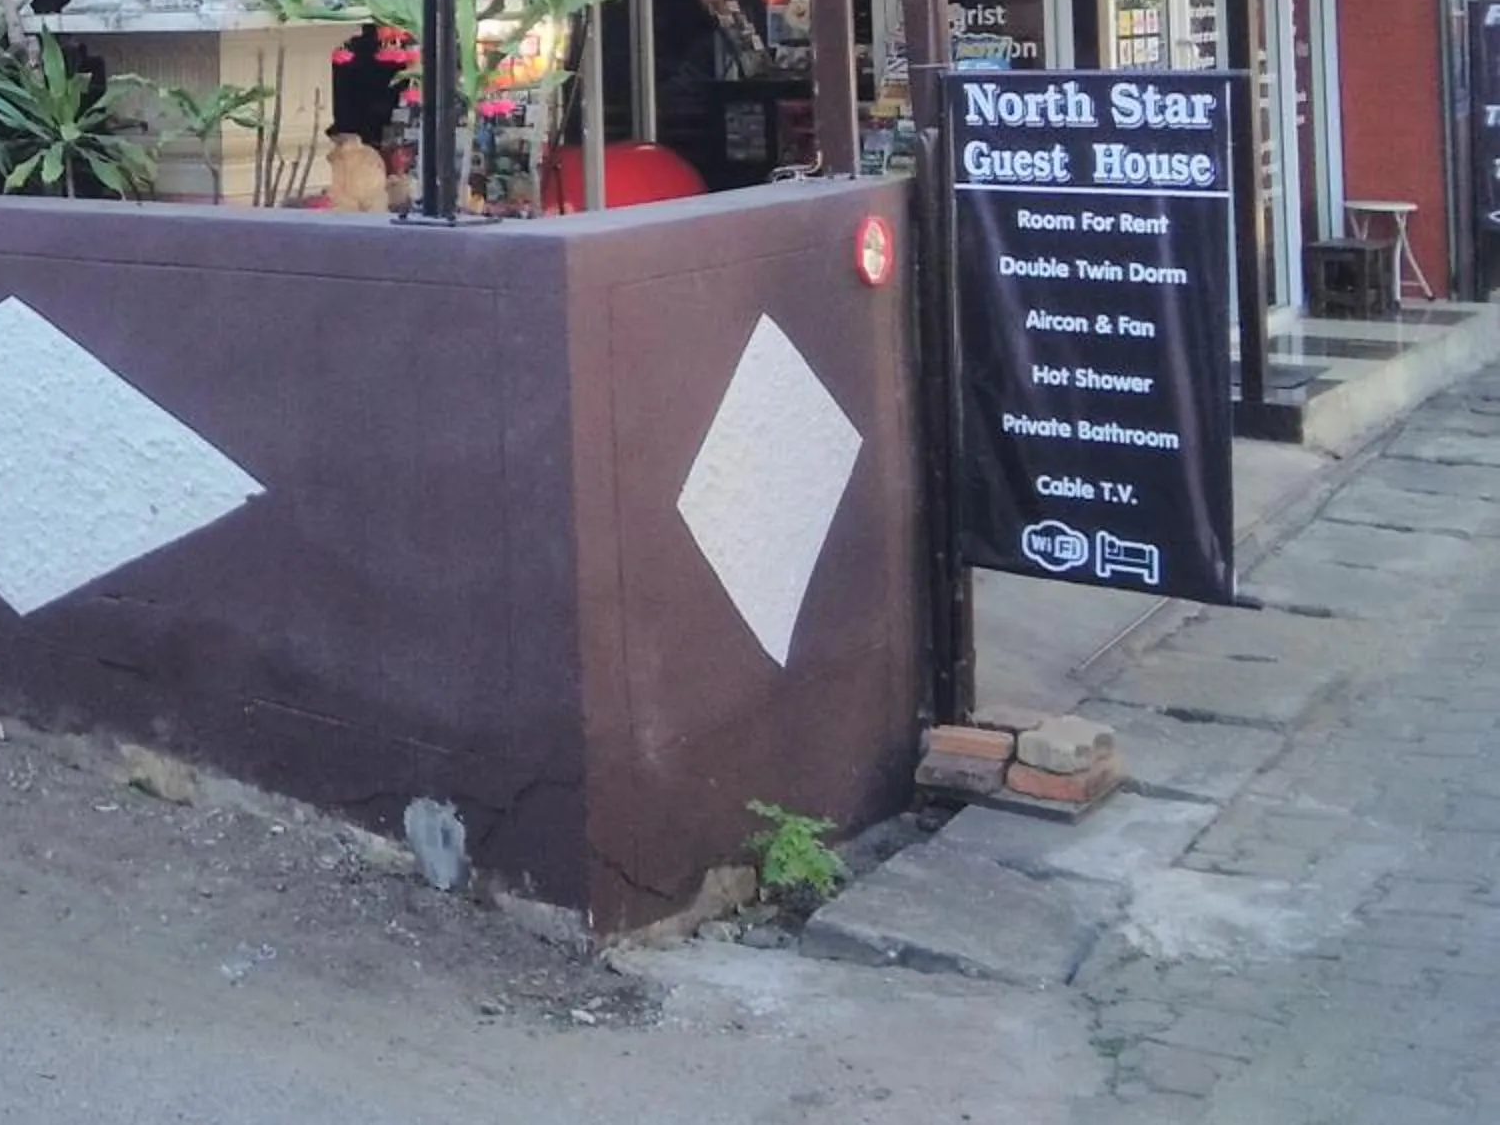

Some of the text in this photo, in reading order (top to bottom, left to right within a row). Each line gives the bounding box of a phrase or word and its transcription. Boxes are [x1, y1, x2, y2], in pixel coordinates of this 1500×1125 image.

[963, 81, 1216, 128] North Star
[963, 140, 1215, 186] Guest House
[1017, 210, 1170, 234] Room For Rent
[999, 256, 1187, 284] Double Twin Dorm
[1026, 310, 1156, 338] Aircon & Fan
[1031, 365, 1154, 393] Hot Shower
[1002, 413, 1179, 450] Private Bathroom
[1036, 475, 1139, 505] Cable T.V.
